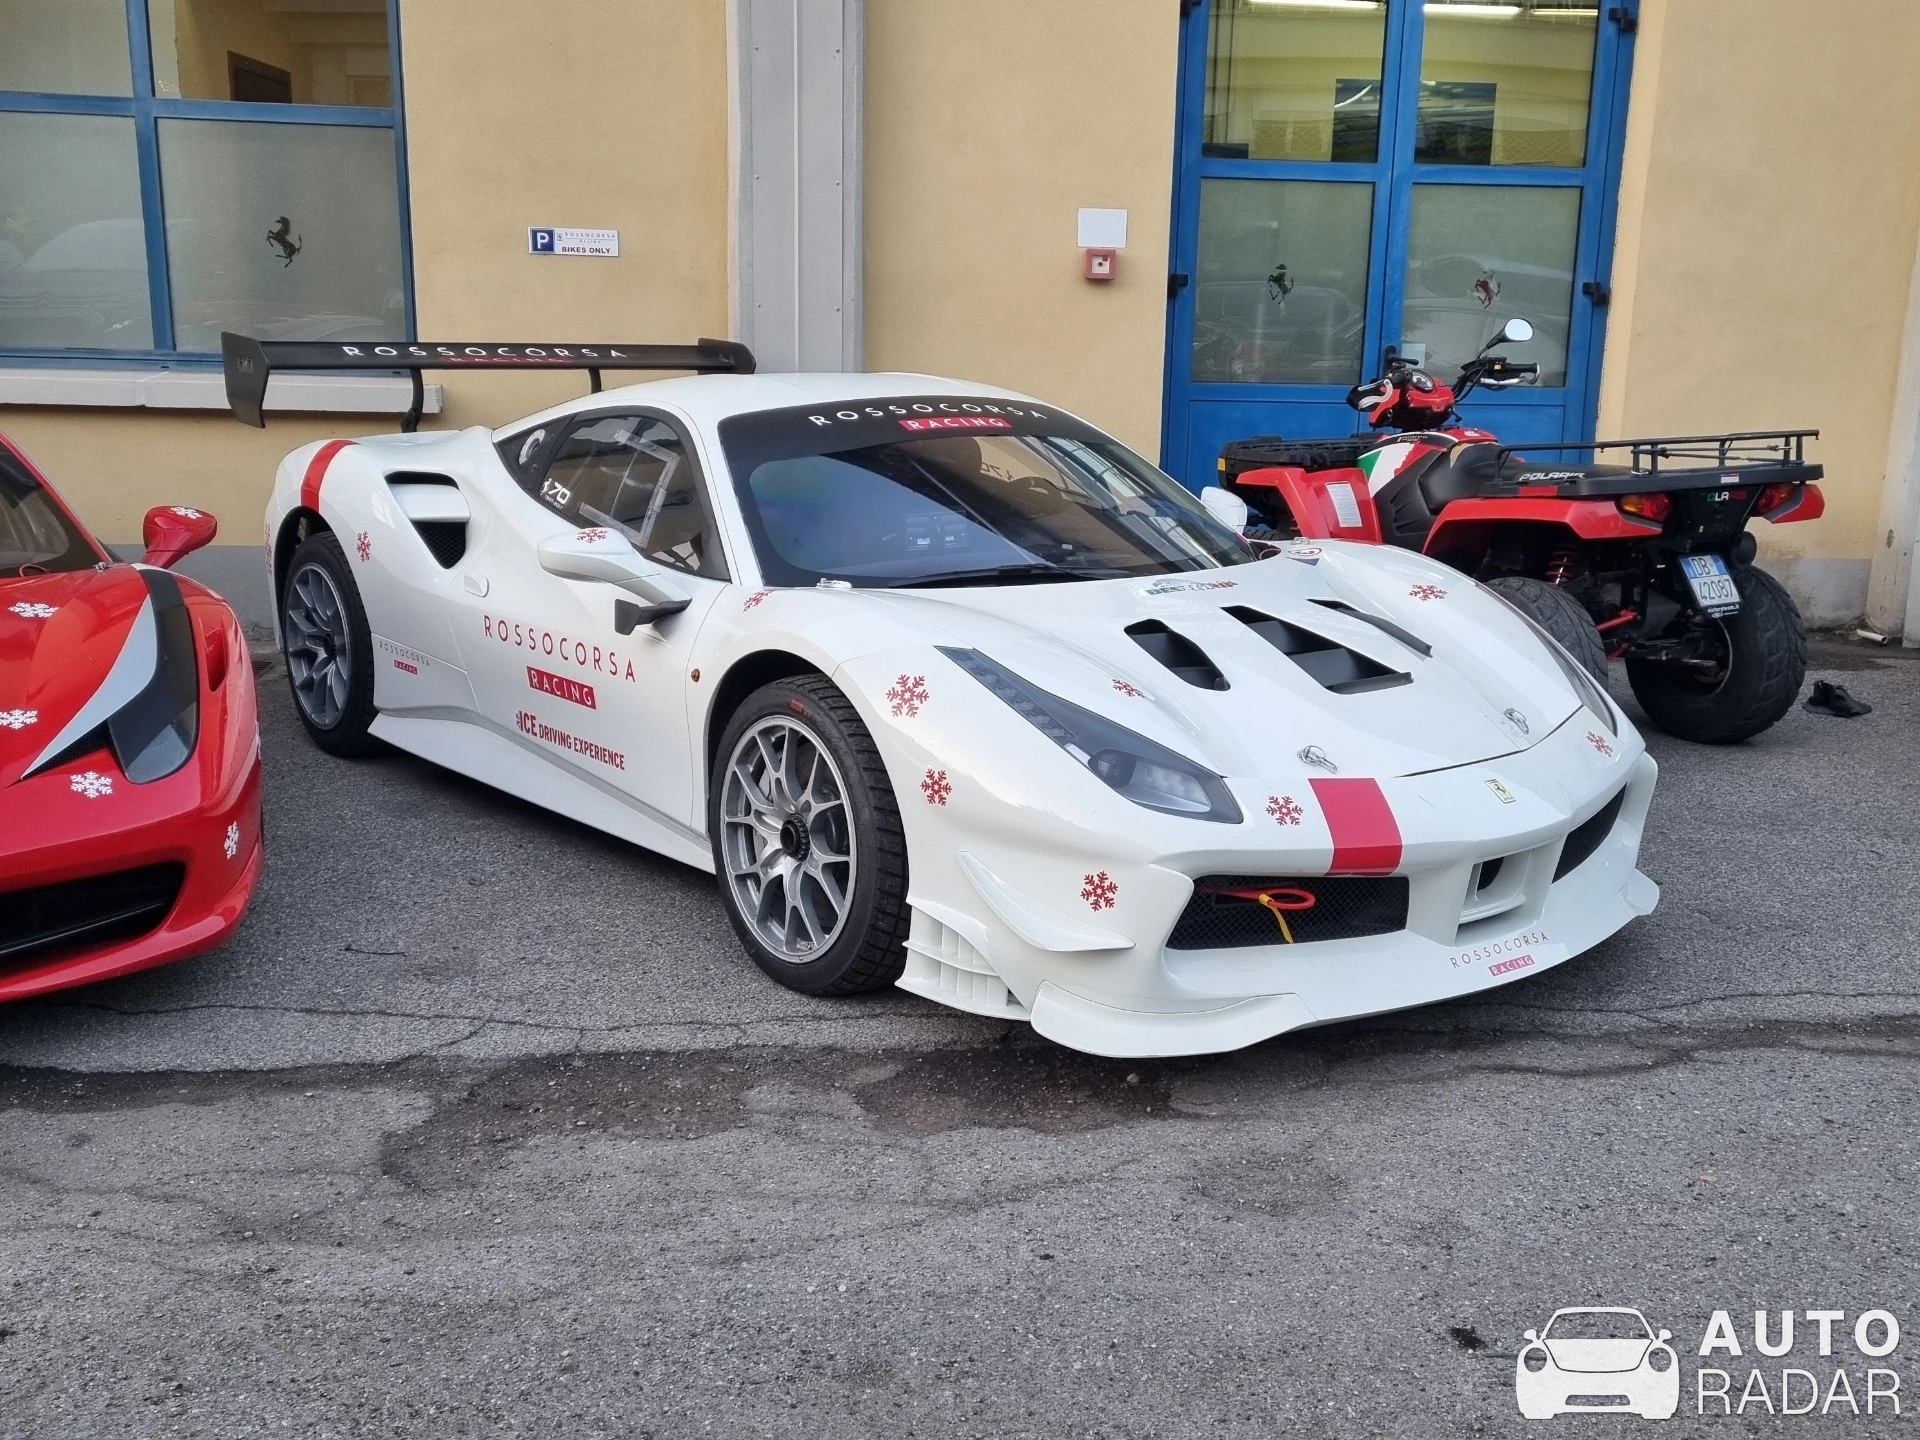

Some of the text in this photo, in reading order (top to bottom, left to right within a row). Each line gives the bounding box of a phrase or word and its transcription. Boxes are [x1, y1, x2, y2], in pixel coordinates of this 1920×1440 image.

[537, 232, 550, 249] P
[564, 231, 616, 239] ROSSOCORSA
[561, 246, 587, 254] BIKES
[341, 345, 628, 358] ROSSOCORSA
[808, 403, 1048, 427] ROSSOCORSA
[907, 418, 1005, 430] RACING
[547, 481, 571, 505] 70
[1690, 557, 1711, 576] DB
[1699, 578, 1733, 601] 42087
[379, 640, 431, 667] ROSSOCORSA
[483, 614, 636, 683] ROSSOCORSA
[394, 660, 418, 675] RACING
[530, 669, 593, 707] RACING
[519, 710, 625, 771] ICE DRIVING EXPERIENCE
[1449, 931, 1549, 969] ROSSOCORSA
[1491, 956, 1533, 976] RACING
